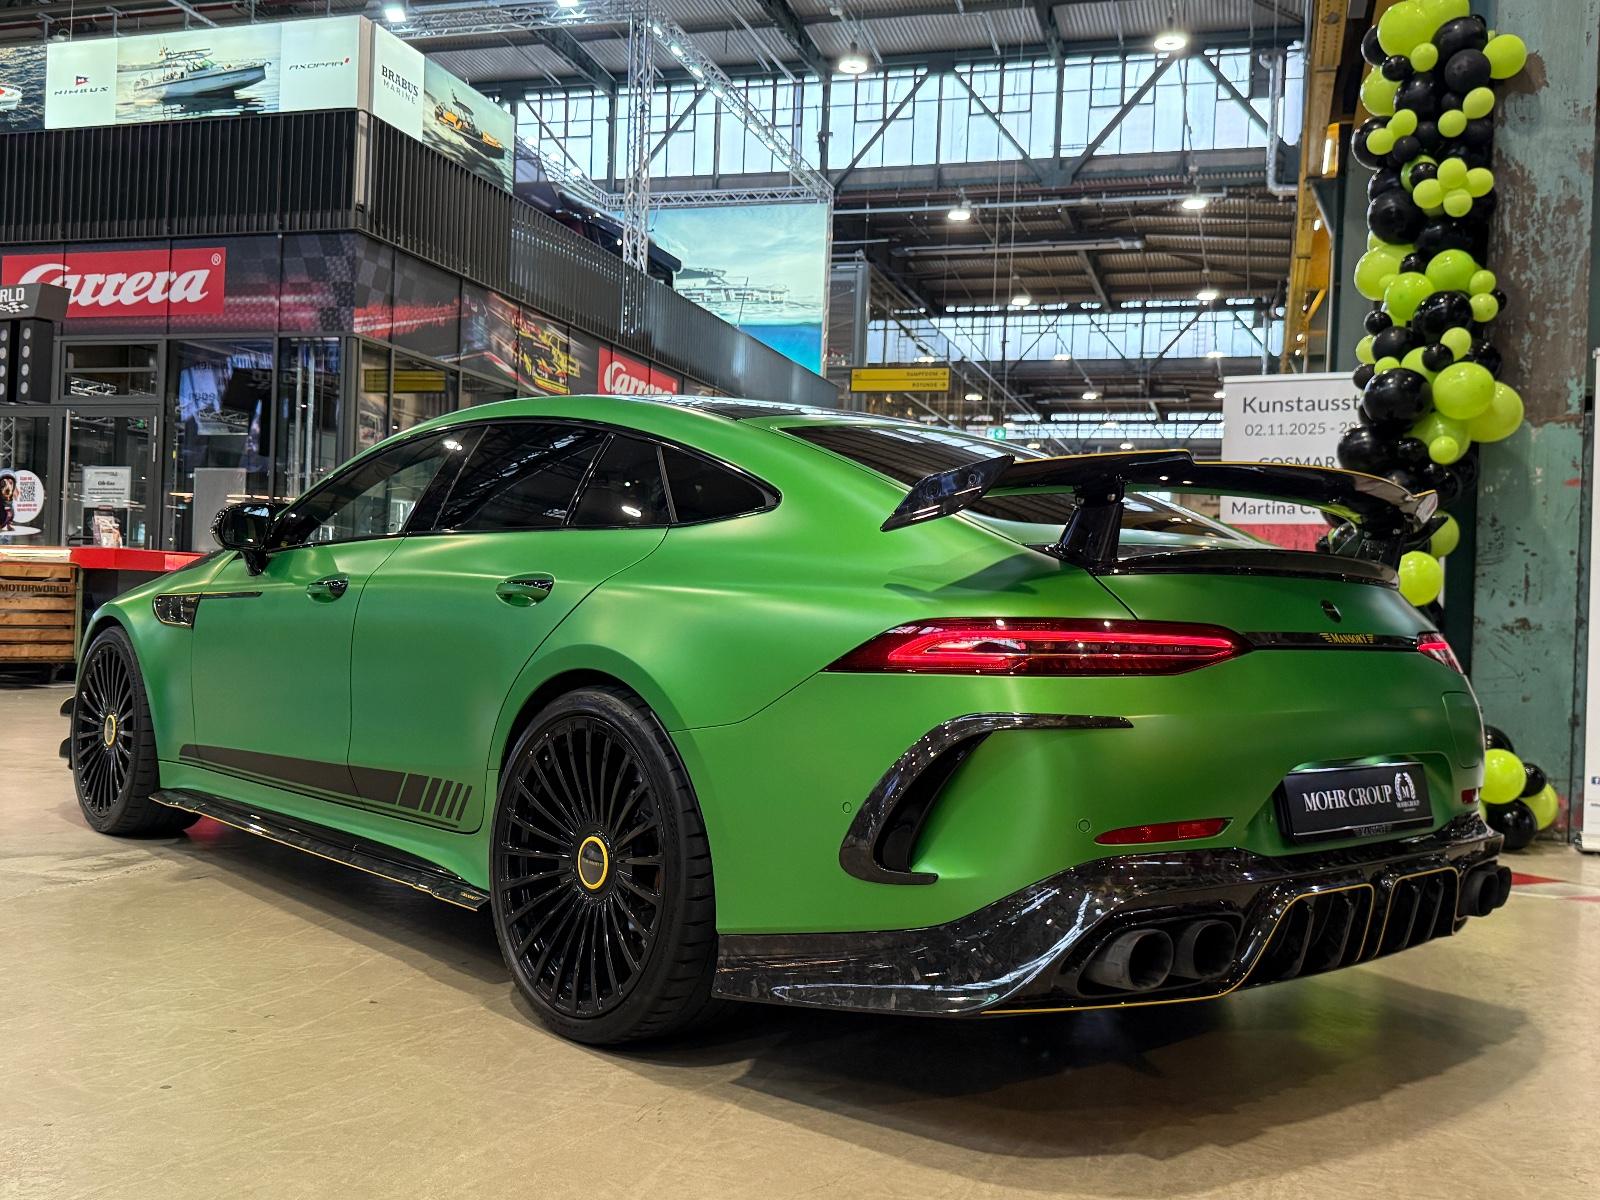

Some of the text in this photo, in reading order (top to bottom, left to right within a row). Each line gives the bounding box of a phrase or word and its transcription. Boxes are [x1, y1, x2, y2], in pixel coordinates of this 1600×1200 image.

[288, 61, 344, 70] AXOPAR
[381, 63, 419, 97] BRABUS
[54, 86, 109, 96] NIMBUS
[383, 78, 416, 105] MARINE
[604, 361, 672, 394] Carre
[1244, 422, 1326, 437] 02.11.2025
[1231, 501, 1316, 516] Martina C.
[0, 583, 68, 593] MOTORWORLD
[1302, 785, 1391, 812] MOHR GROUP
